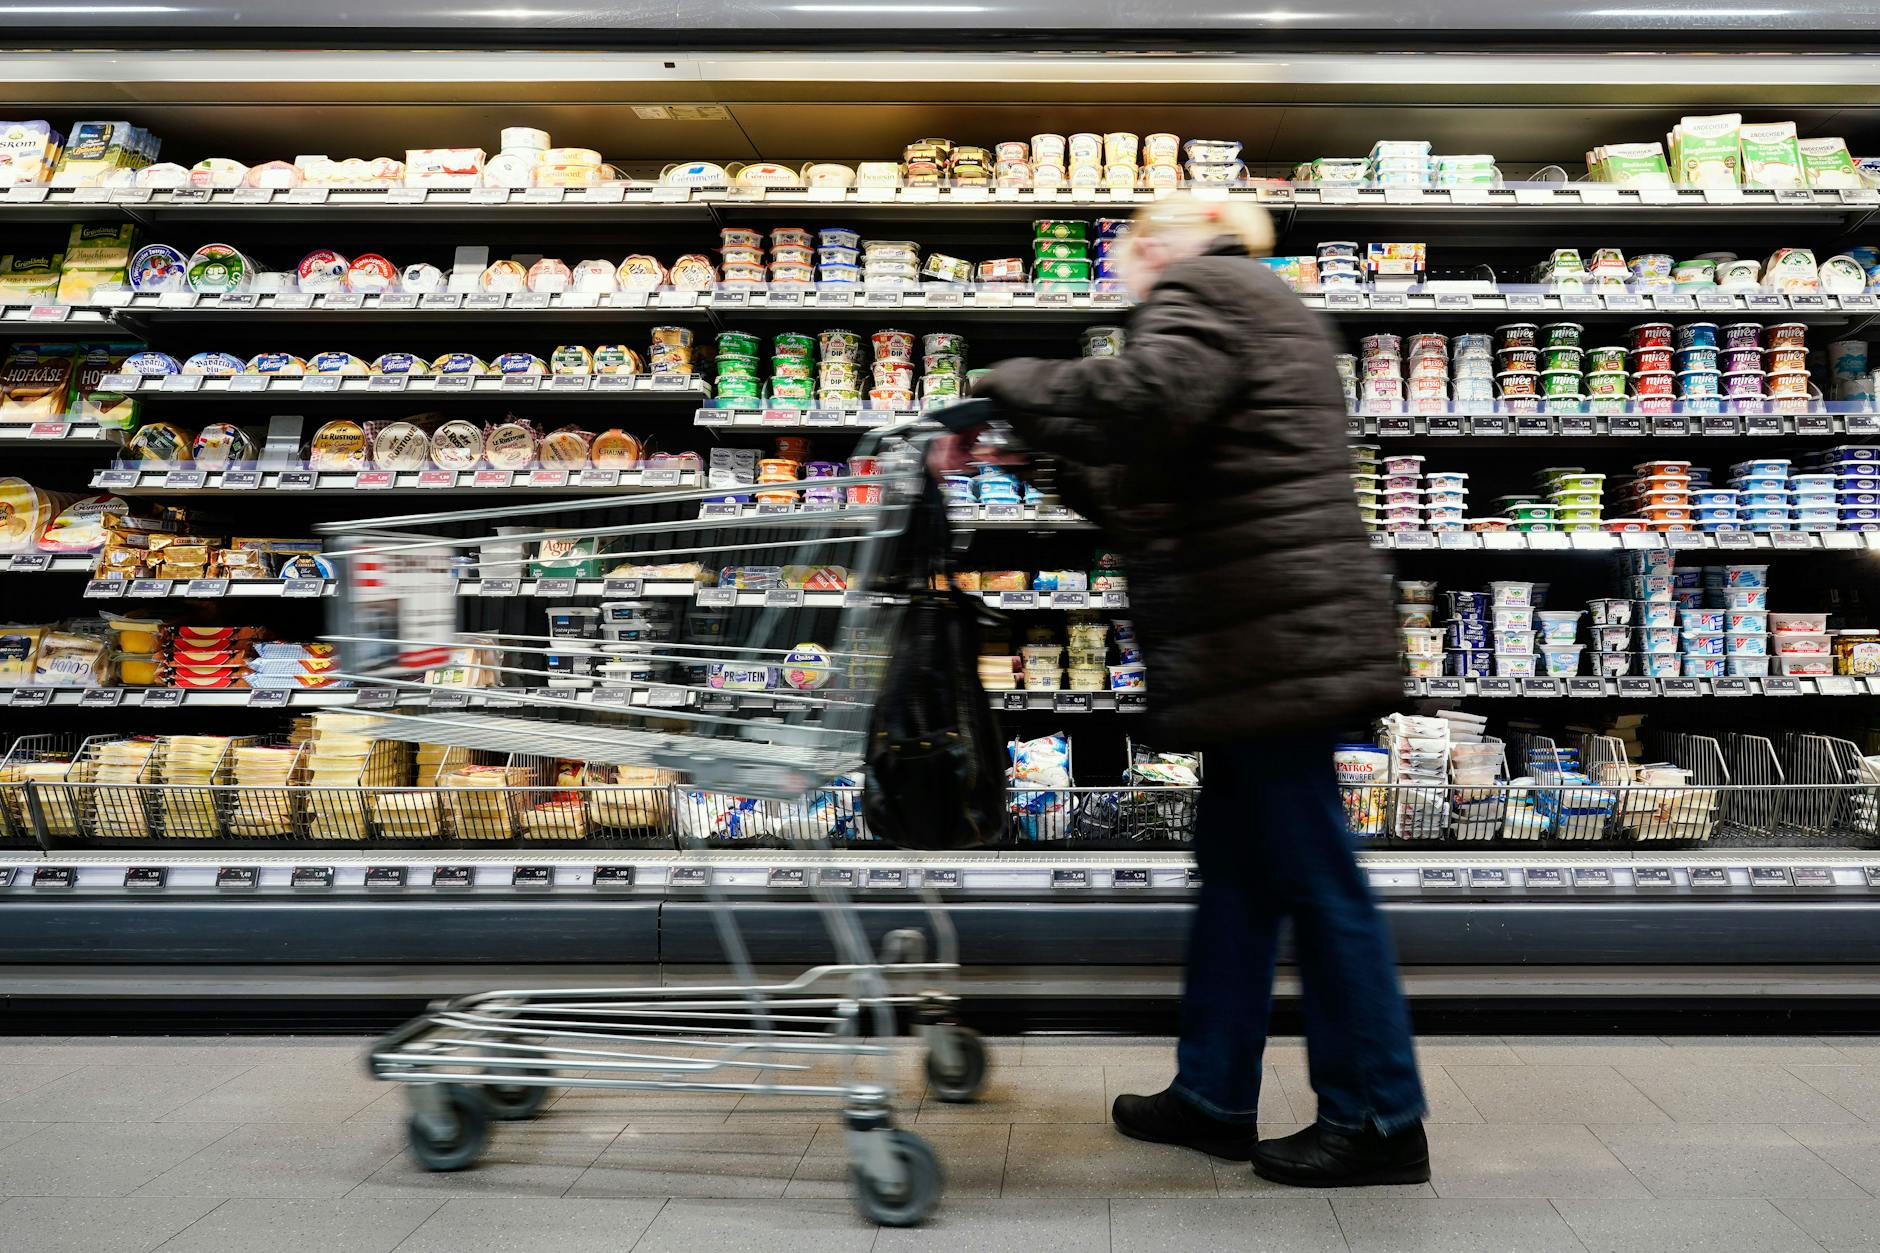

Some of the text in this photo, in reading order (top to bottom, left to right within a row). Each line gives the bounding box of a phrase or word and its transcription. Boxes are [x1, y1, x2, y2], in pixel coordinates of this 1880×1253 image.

[1507, 327, 1534, 339] miree
[1551, 327, 1579, 339] miree
[1645, 327, 1671, 338] miree
[1727, 327, 1756, 339] miree
[1777, 327, 1805, 338] miree
[1642, 351, 1670, 362] miree
[1690, 350, 1717, 361] miree
[1733, 351, 1761, 362] miree
[1776, 351, 1804, 361] miree
[7, 365, 64, 382] HOFKÄSE
[1691, 373, 1718, 384] miree
[1503, 375, 1531, 386] miree
[1552, 374, 1580, 385] miree
[1646, 374, 1672, 386] miree
[1730, 374, 1760, 386] miree
[1778, 374, 1806, 385] miree
[329, 433, 361, 441] RUSTIQUE
[73, 502, 122, 512] Géramont
[1336, 762, 1373, 772] PATROS
